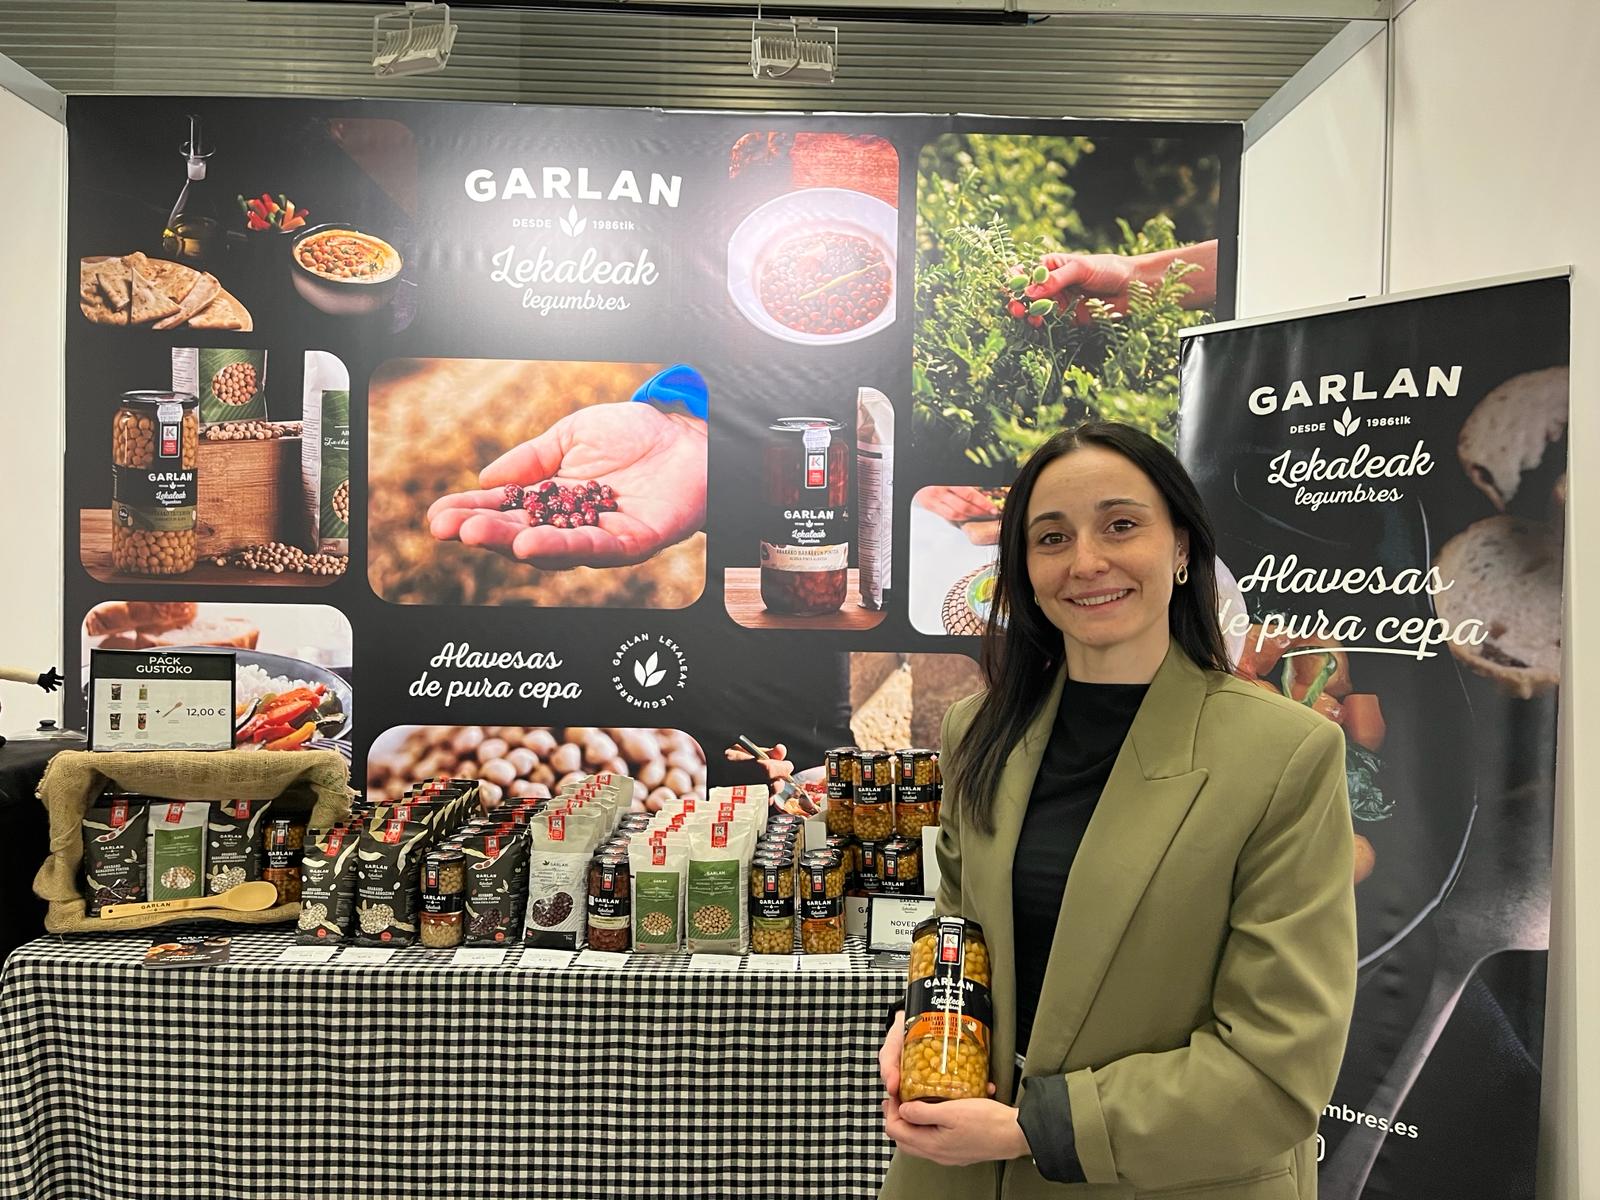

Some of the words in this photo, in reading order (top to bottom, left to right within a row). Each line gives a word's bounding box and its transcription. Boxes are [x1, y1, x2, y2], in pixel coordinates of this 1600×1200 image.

[464, 166, 682, 208] GARLAN
[512, 218, 552, 228] DESDE
[592, 220, 635, 230] 1986tik
[490, 244, 660, 288] Lekaleak
[522, 288, 630, 316] legumbres
[1248, 366, 1462, 416] GARLAN
[1290, 422, 1326, 434] DESDE
[1366, 415, 1411, 428] 1986tik
[148, 472, 192, 482] GARLAN
[1267, 440, 1435, 488] Lekaleak
[1294, 483, 1404, 511] legumbres
[784, 510, 834, 520] GARLAN
[1236, 554, 1454, 596] Alavesas
[1254, 608, 1366, 653] pura
[1375, 613, 1490, 660] cepa
[149, 656, 181, 665] PACK
[430, 642, 563, 670] Alavesas
[612, 633, 648, 666] GARLAN
[658, 635, 688, 688] LEKALEAK
[135, 664, 193, 674] GUSTOKO
[408, 671, 443, 697] de
[444, 677, 514, 707] pura
[518, 680, 582, 708] cepa
[612, 676, 674, 708] LEGUMBRES
[186, 708, 214, 718] 12,00
[218, 708, 226, 716] €
[924, 977, 974, 992] GARLAN
[1321, 1104, 1418, 1139] mbres.es
